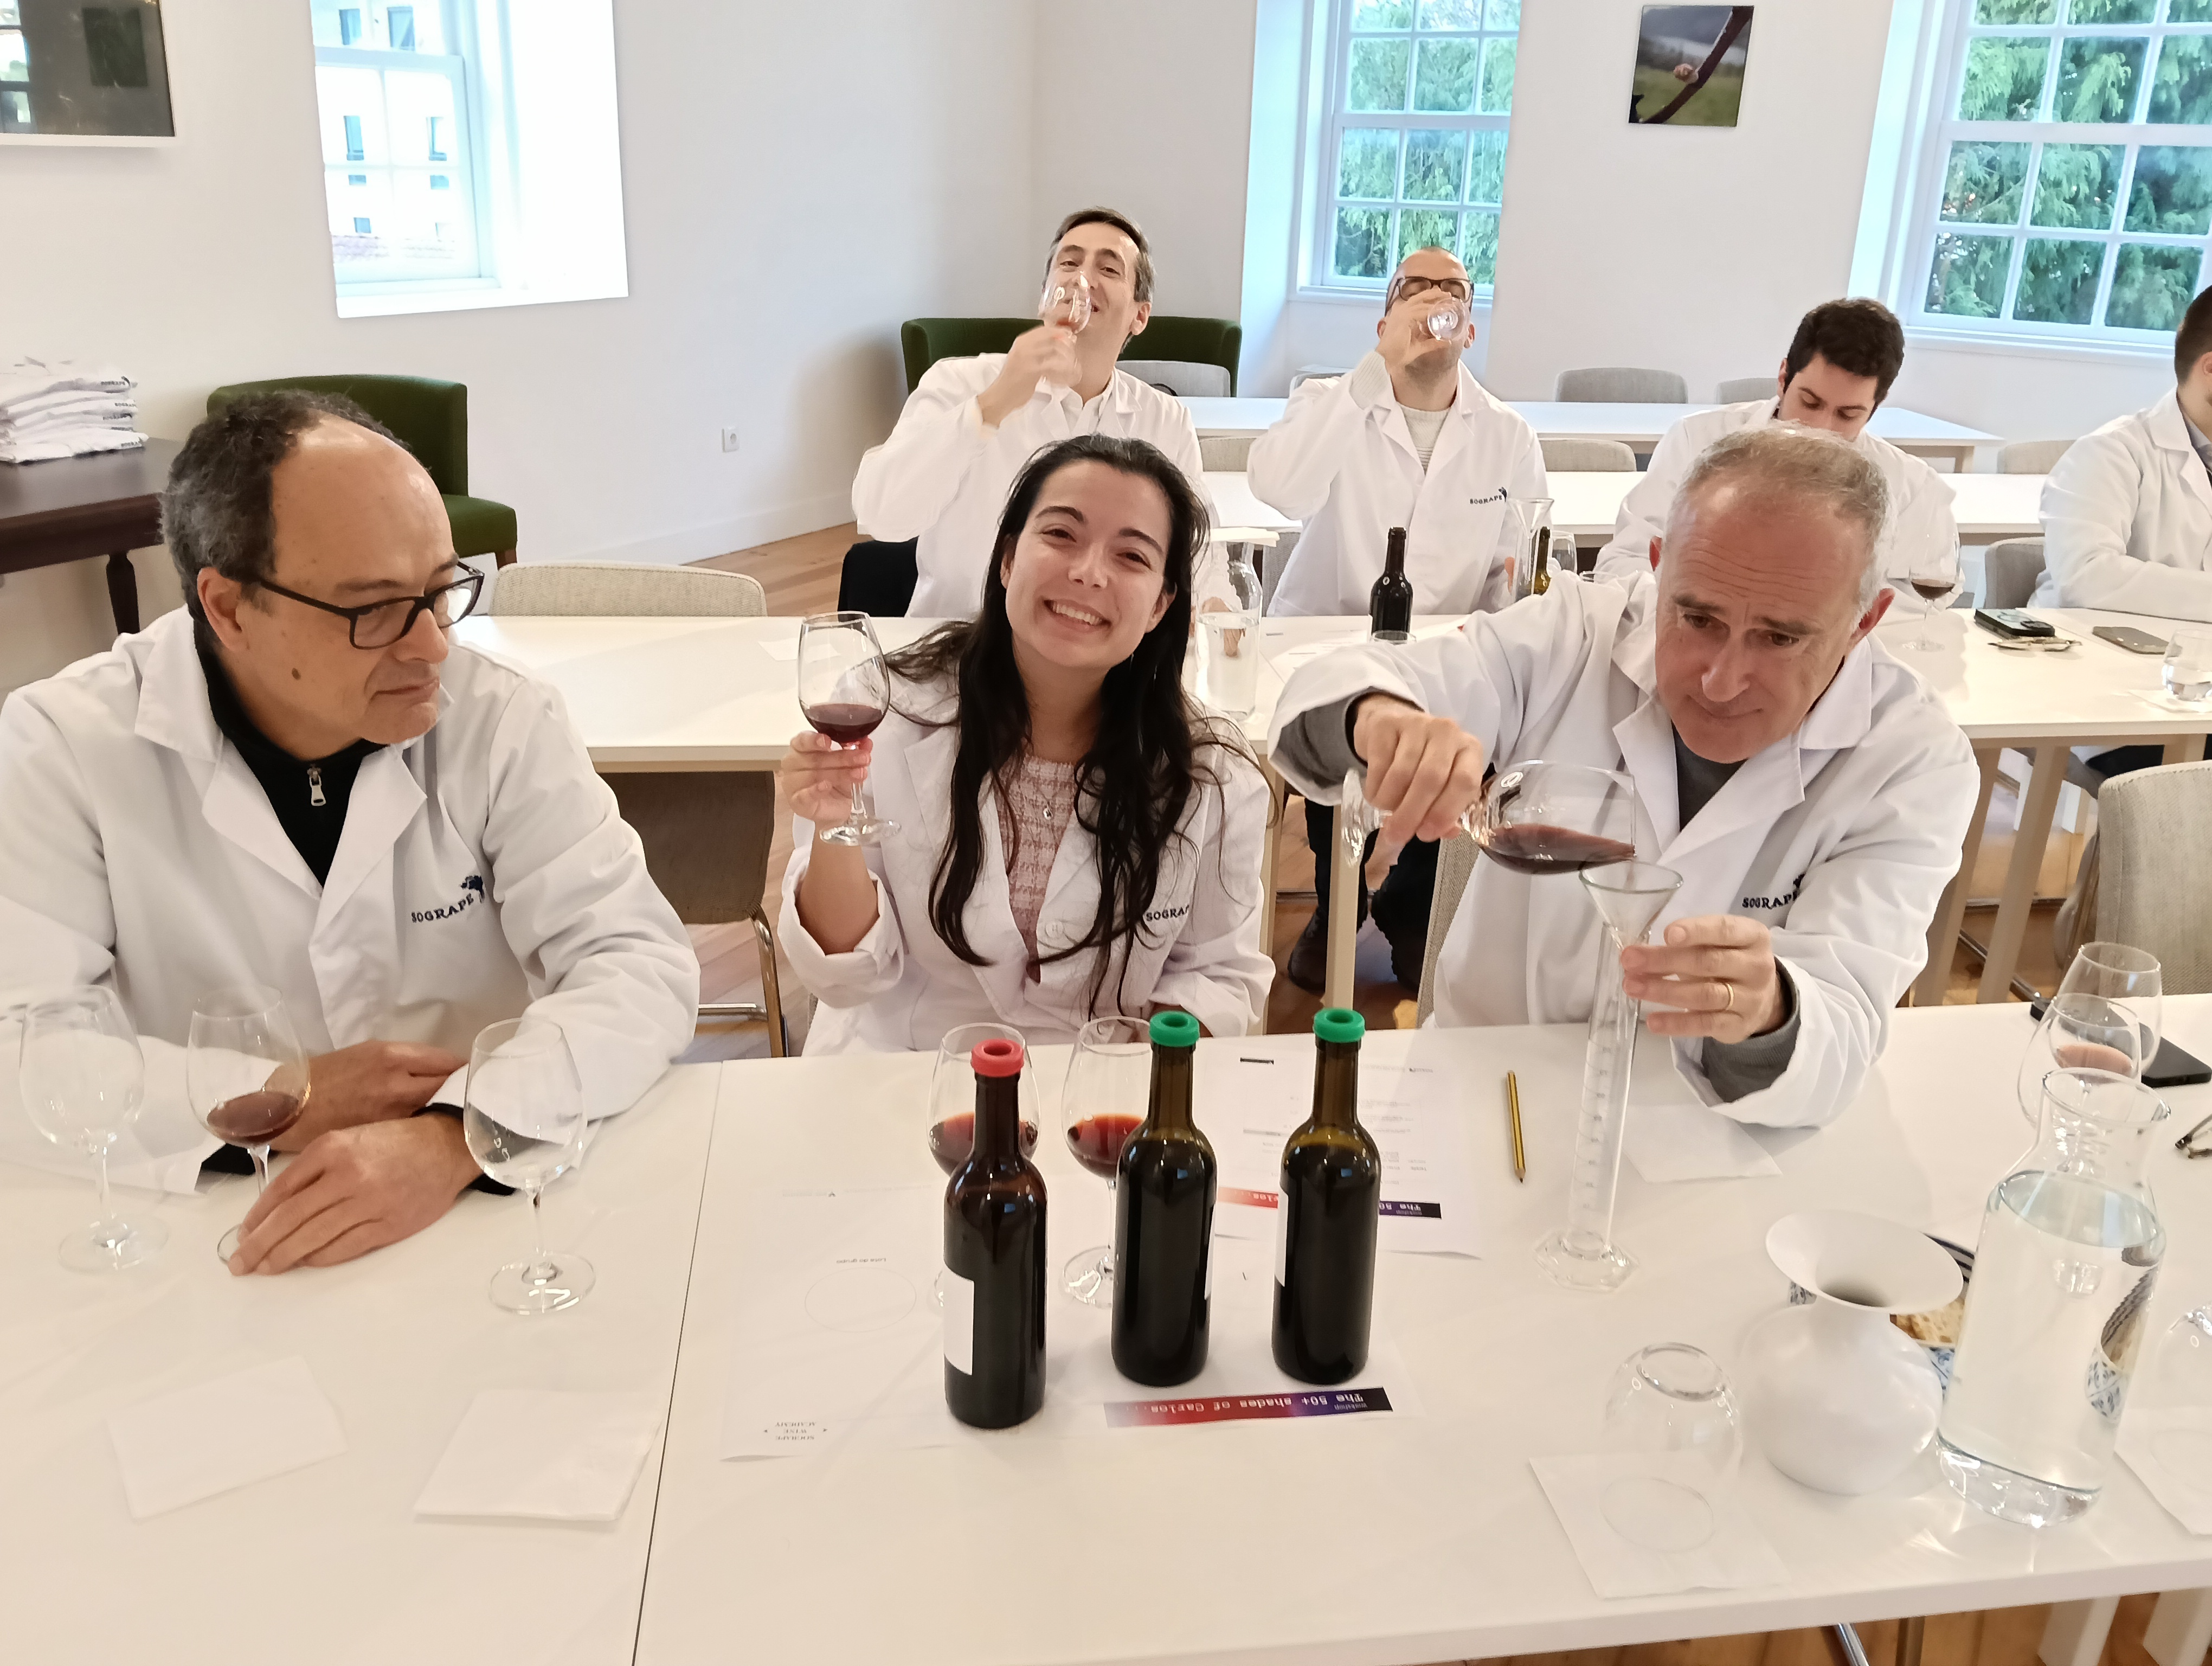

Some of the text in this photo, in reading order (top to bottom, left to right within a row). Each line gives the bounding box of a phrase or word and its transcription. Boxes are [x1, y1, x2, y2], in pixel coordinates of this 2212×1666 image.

[411, 893, 474, 923] SOGRAPE
[1239, 1397, 1291, 1409] shades
[1301, 1395, 1328, 1406] 50+
[1335, 1393, 1364, 1402] The
[1213, 1400, 1230, 1411] of
